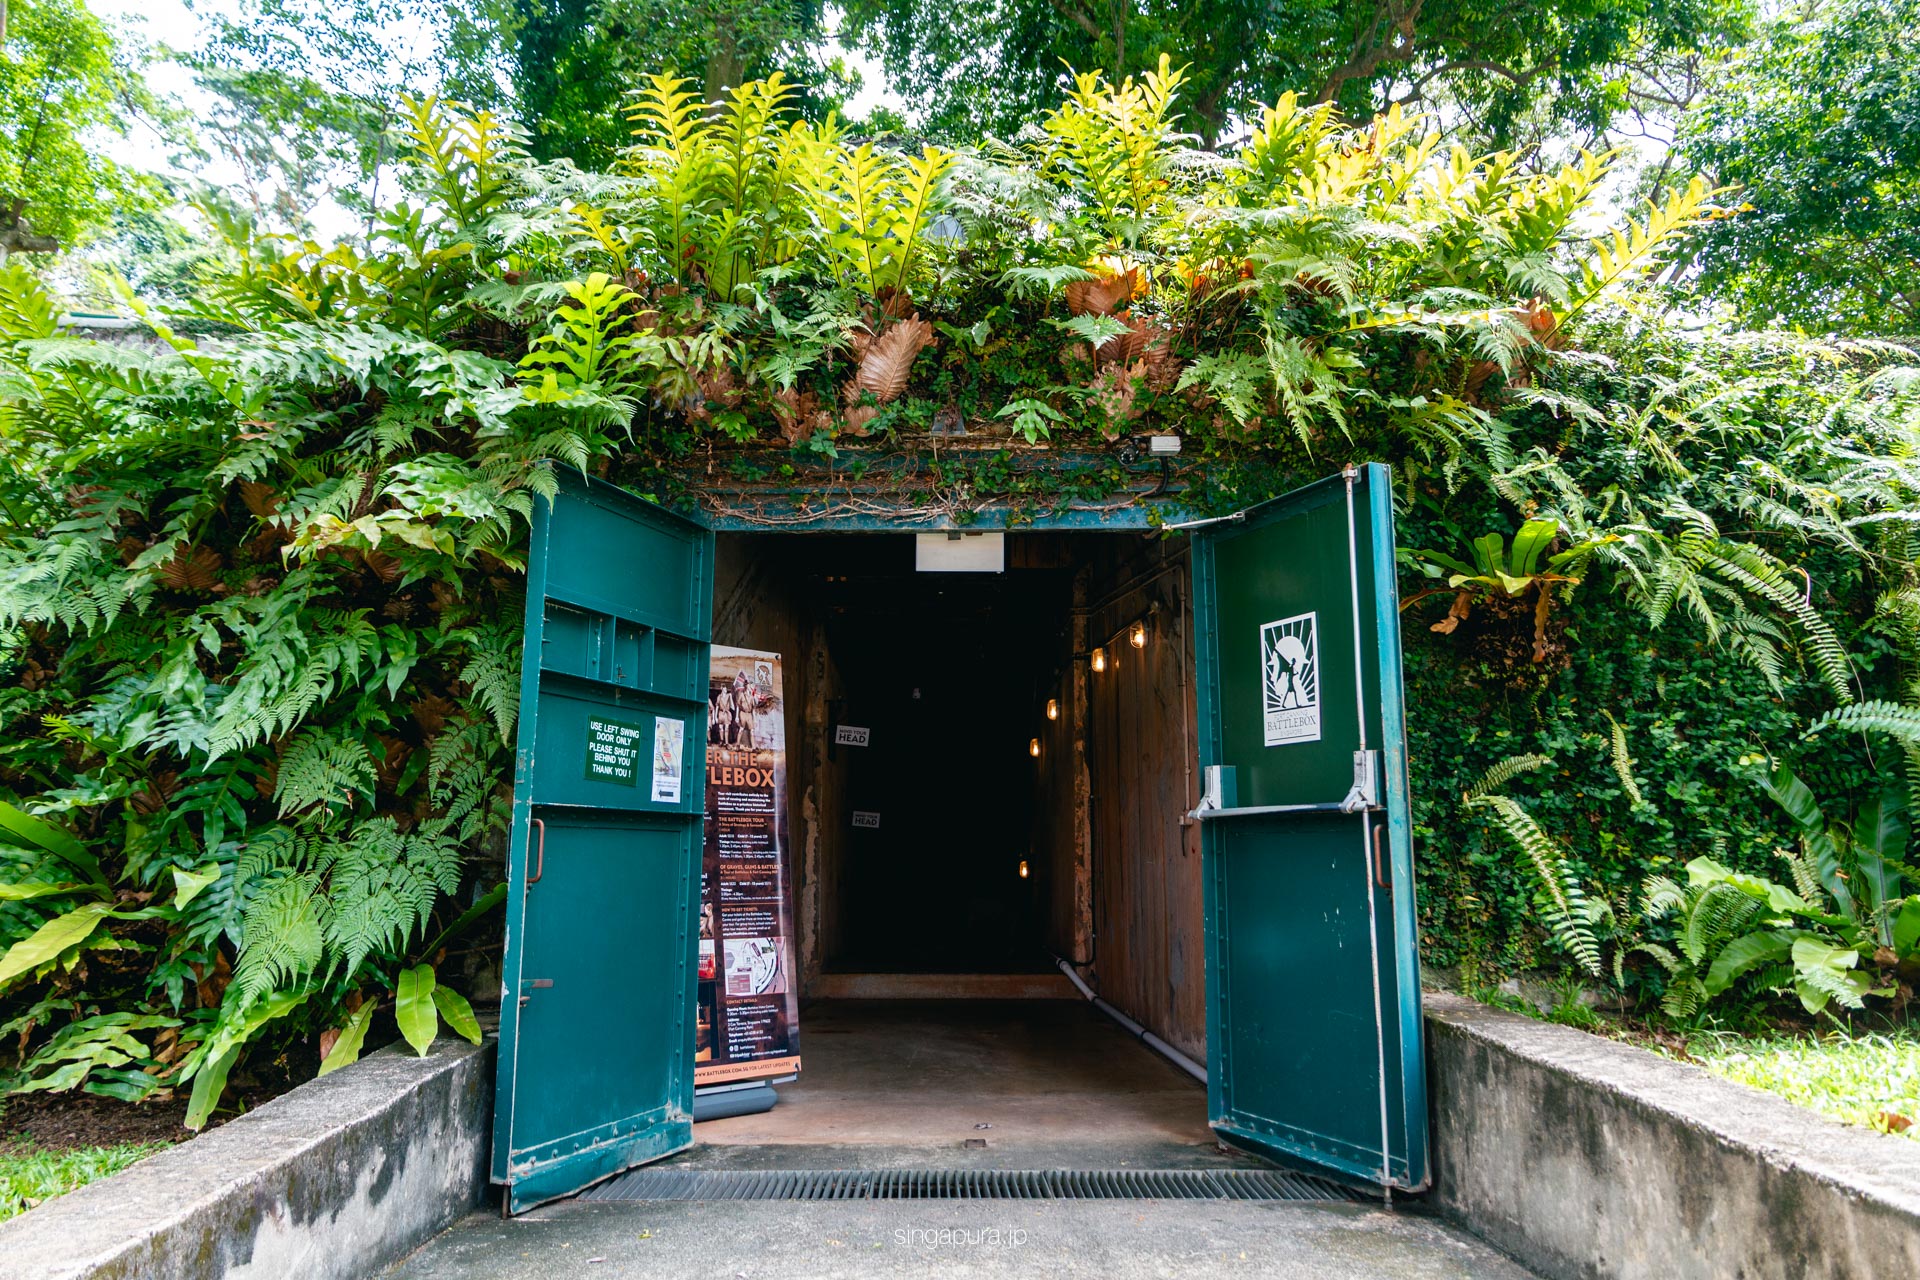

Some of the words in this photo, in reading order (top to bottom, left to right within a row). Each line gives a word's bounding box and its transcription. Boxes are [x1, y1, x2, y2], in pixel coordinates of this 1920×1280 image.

[591, 722, 602, 731] USE
[604, 724, 619, 734] LEFT
[620, 727, 639, 738] SWING
[1267, 715, 1316, 731] BATTLEBOX
[597, 732, 614, 742] DOOR
[616, 736, 632, 746] ONLY
[839, 733, 866, 743] HEAD
[589, 742, 612, 754] PLEASE
[614, 747, 629, 756] SHUT
[631, 750, 637, 758] IT
[594, 753, 616, 764] BEHIND
[618, 757, 630, 766] YOU
[728, 751, 757, 766] THE
[592, 764, 612, 774] THANK
[614, 768, 627, 777] YOU
[854, 817, 877, 826] HEAD
